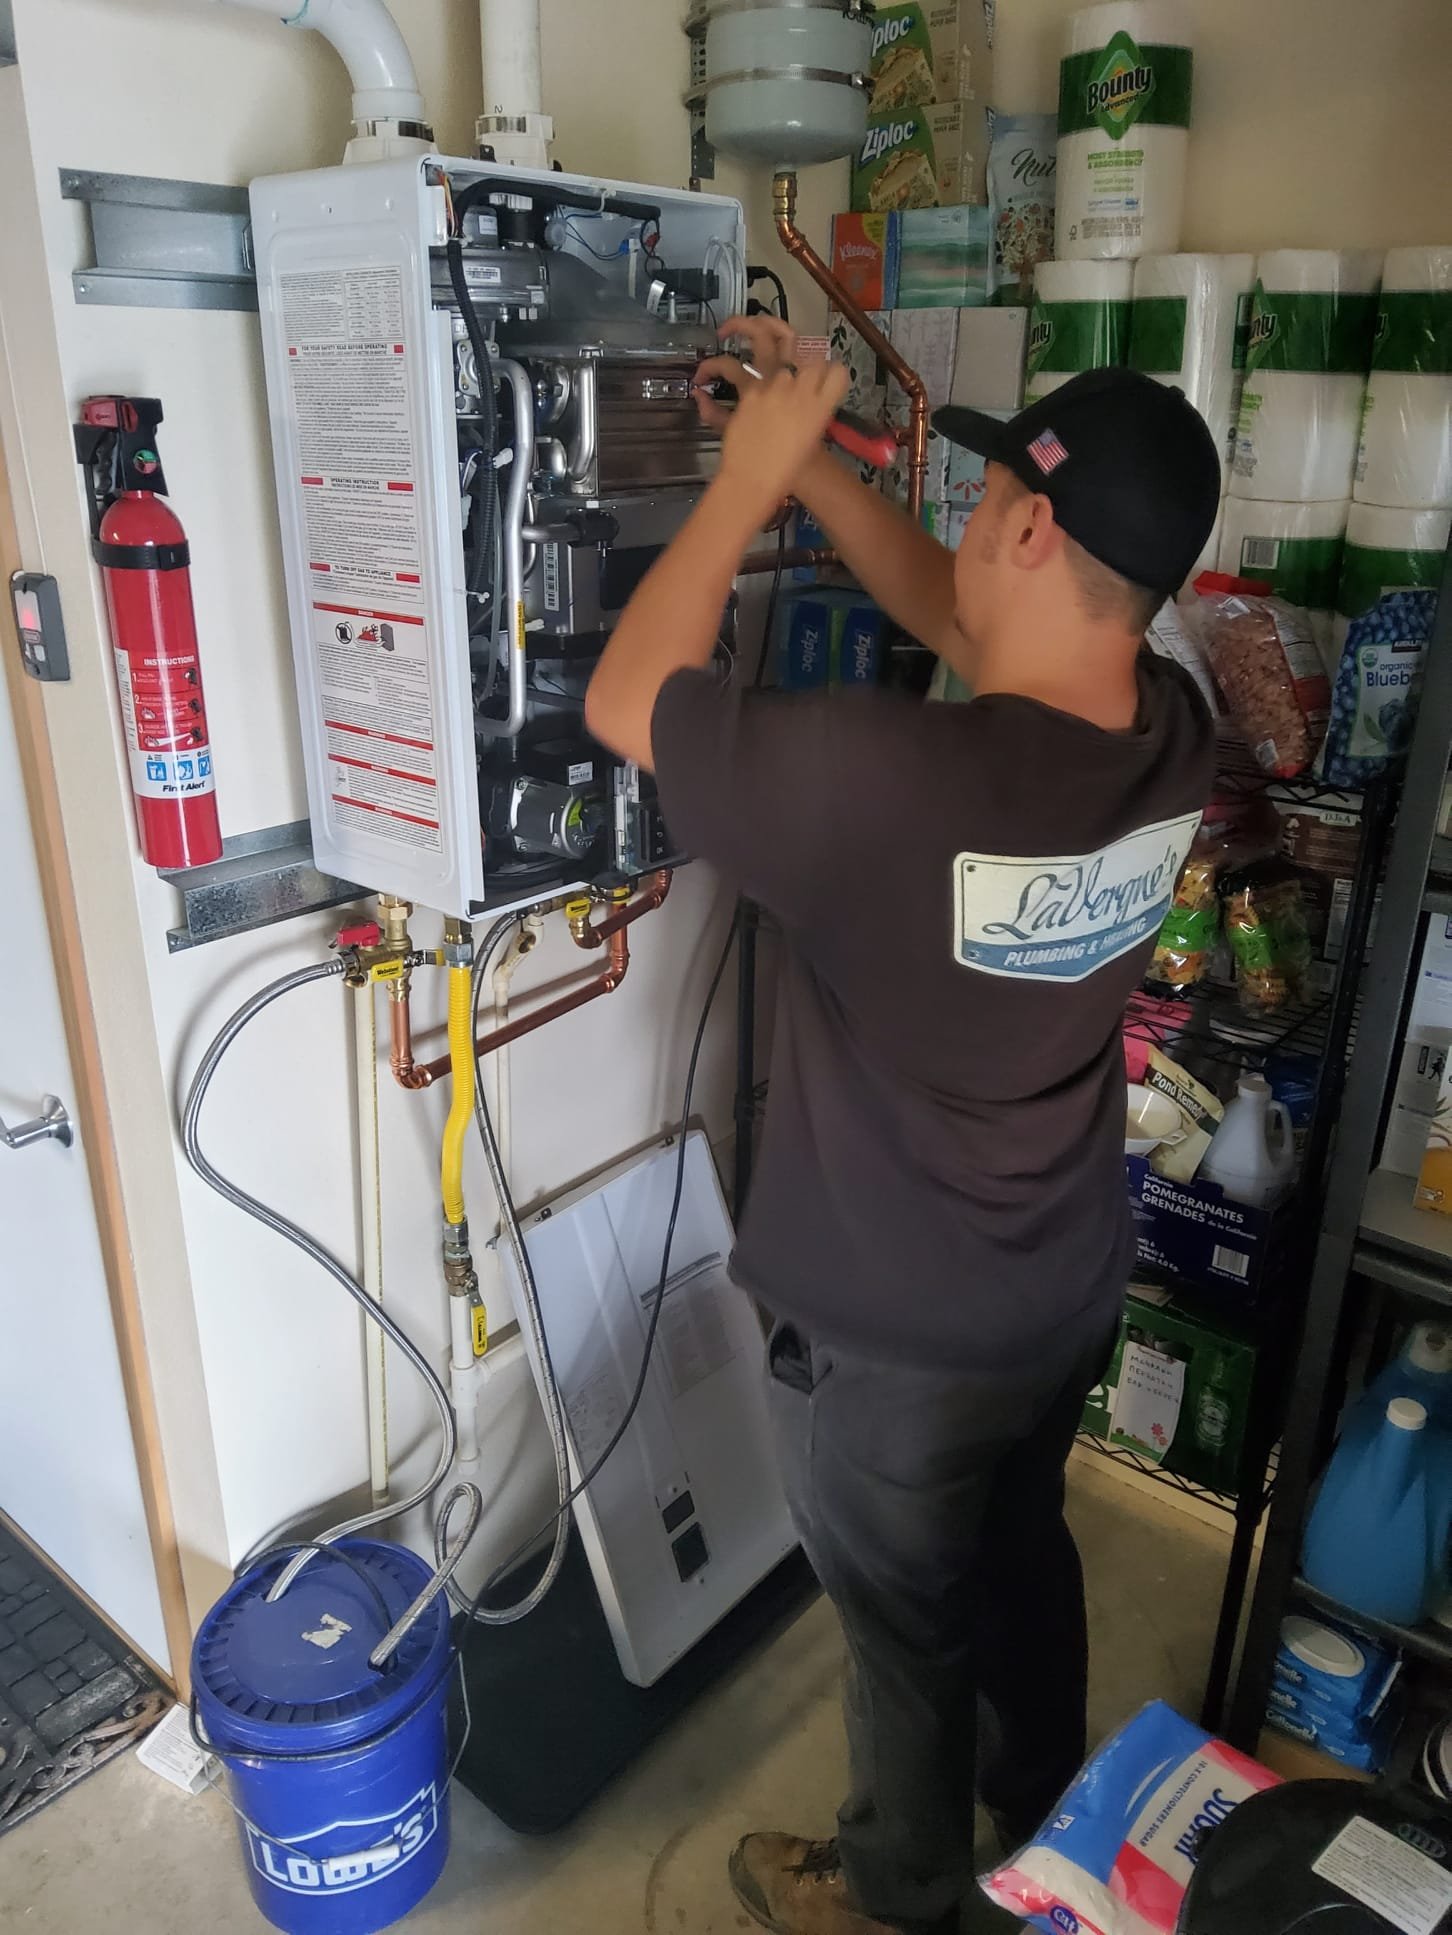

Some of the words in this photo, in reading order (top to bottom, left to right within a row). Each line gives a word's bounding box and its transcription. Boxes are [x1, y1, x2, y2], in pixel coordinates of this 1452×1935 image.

[871, 15, 910, 57] ploc
[1087, 65, 1152, 114] Bounty
[860, 120, 914, 162] Ziploc
[1032, 320, 1053, 345] nty
[1251, 312, 1277, 340] nty
[801, 628, 818, 673] Ziploc
[854, 632, 873, 680] Ziploc
[162, 782, 184, 793] Firt
[1004, 942, 1085, 968] PLUMBING
[1087, 941, 1098, 955] &
[1152, 1071, 1177, 1096] Pond
[1141, 1192, 1206, 1223] GRENADES
[1142, 1181, 1245, 1224] POMEGRANATES
[261, 1808, 424, 1887] LOW'S
